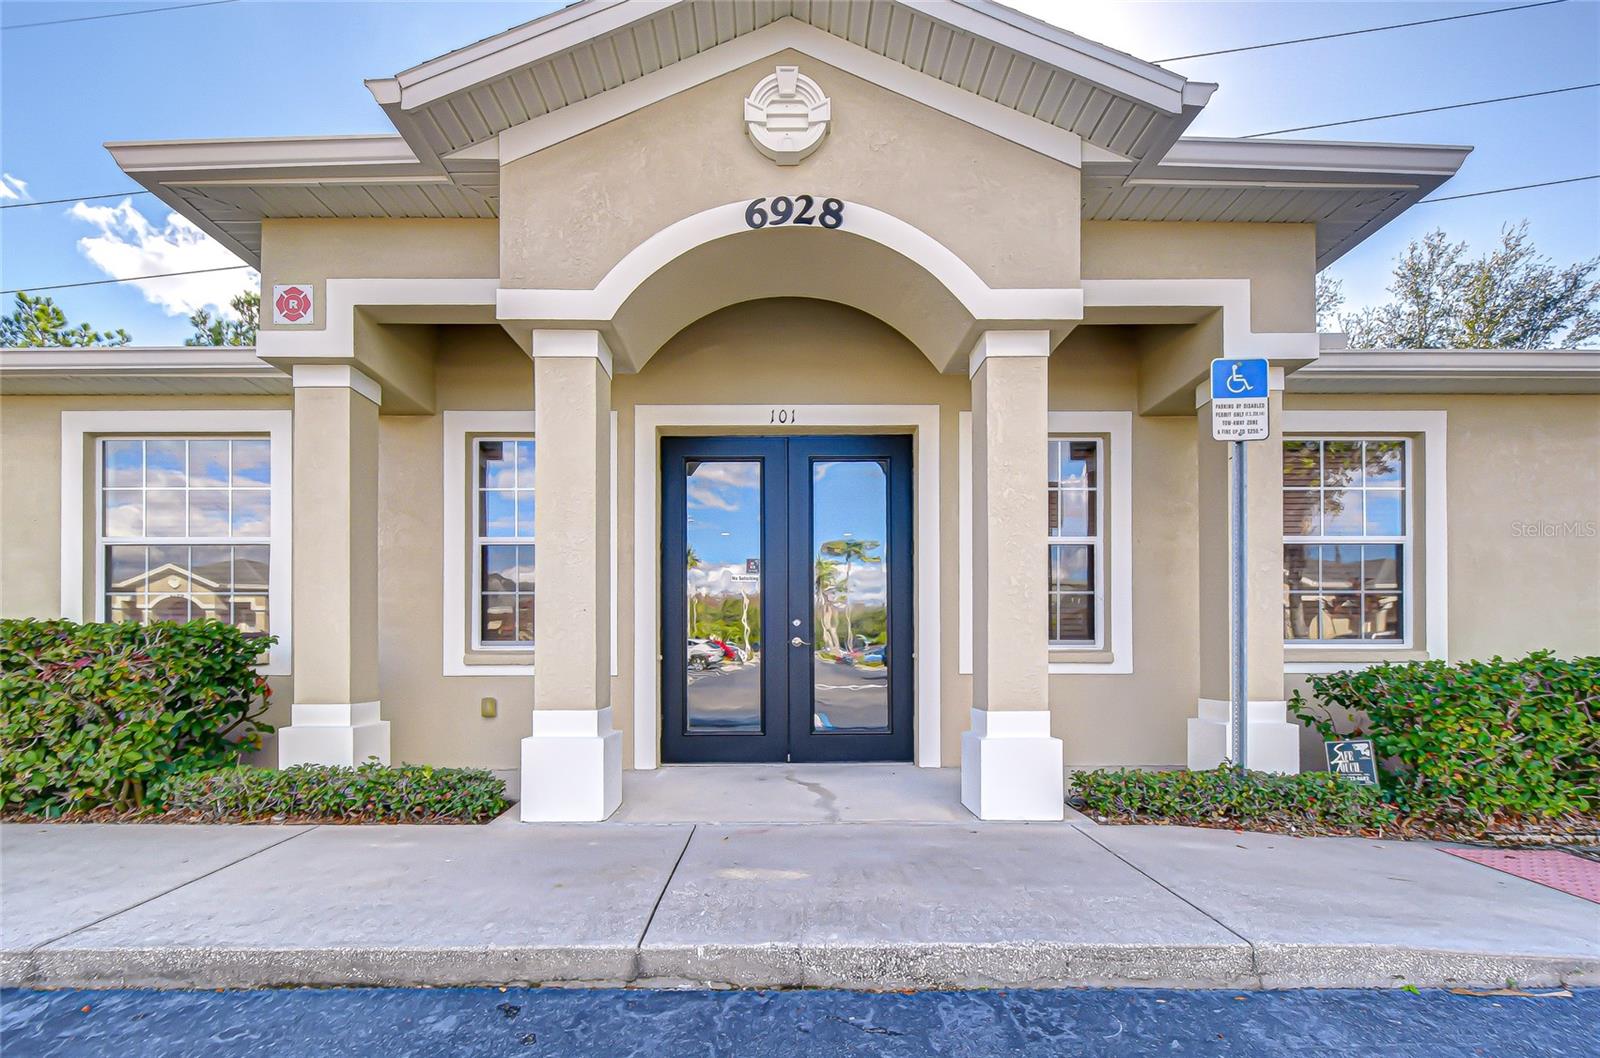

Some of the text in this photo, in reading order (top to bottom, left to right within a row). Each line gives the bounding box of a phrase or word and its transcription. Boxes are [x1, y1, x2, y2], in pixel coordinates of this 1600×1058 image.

[745, 195, 844, 229] 6928
[289, 300, 298, 309] R
[770, 409, 795, 424] 101
